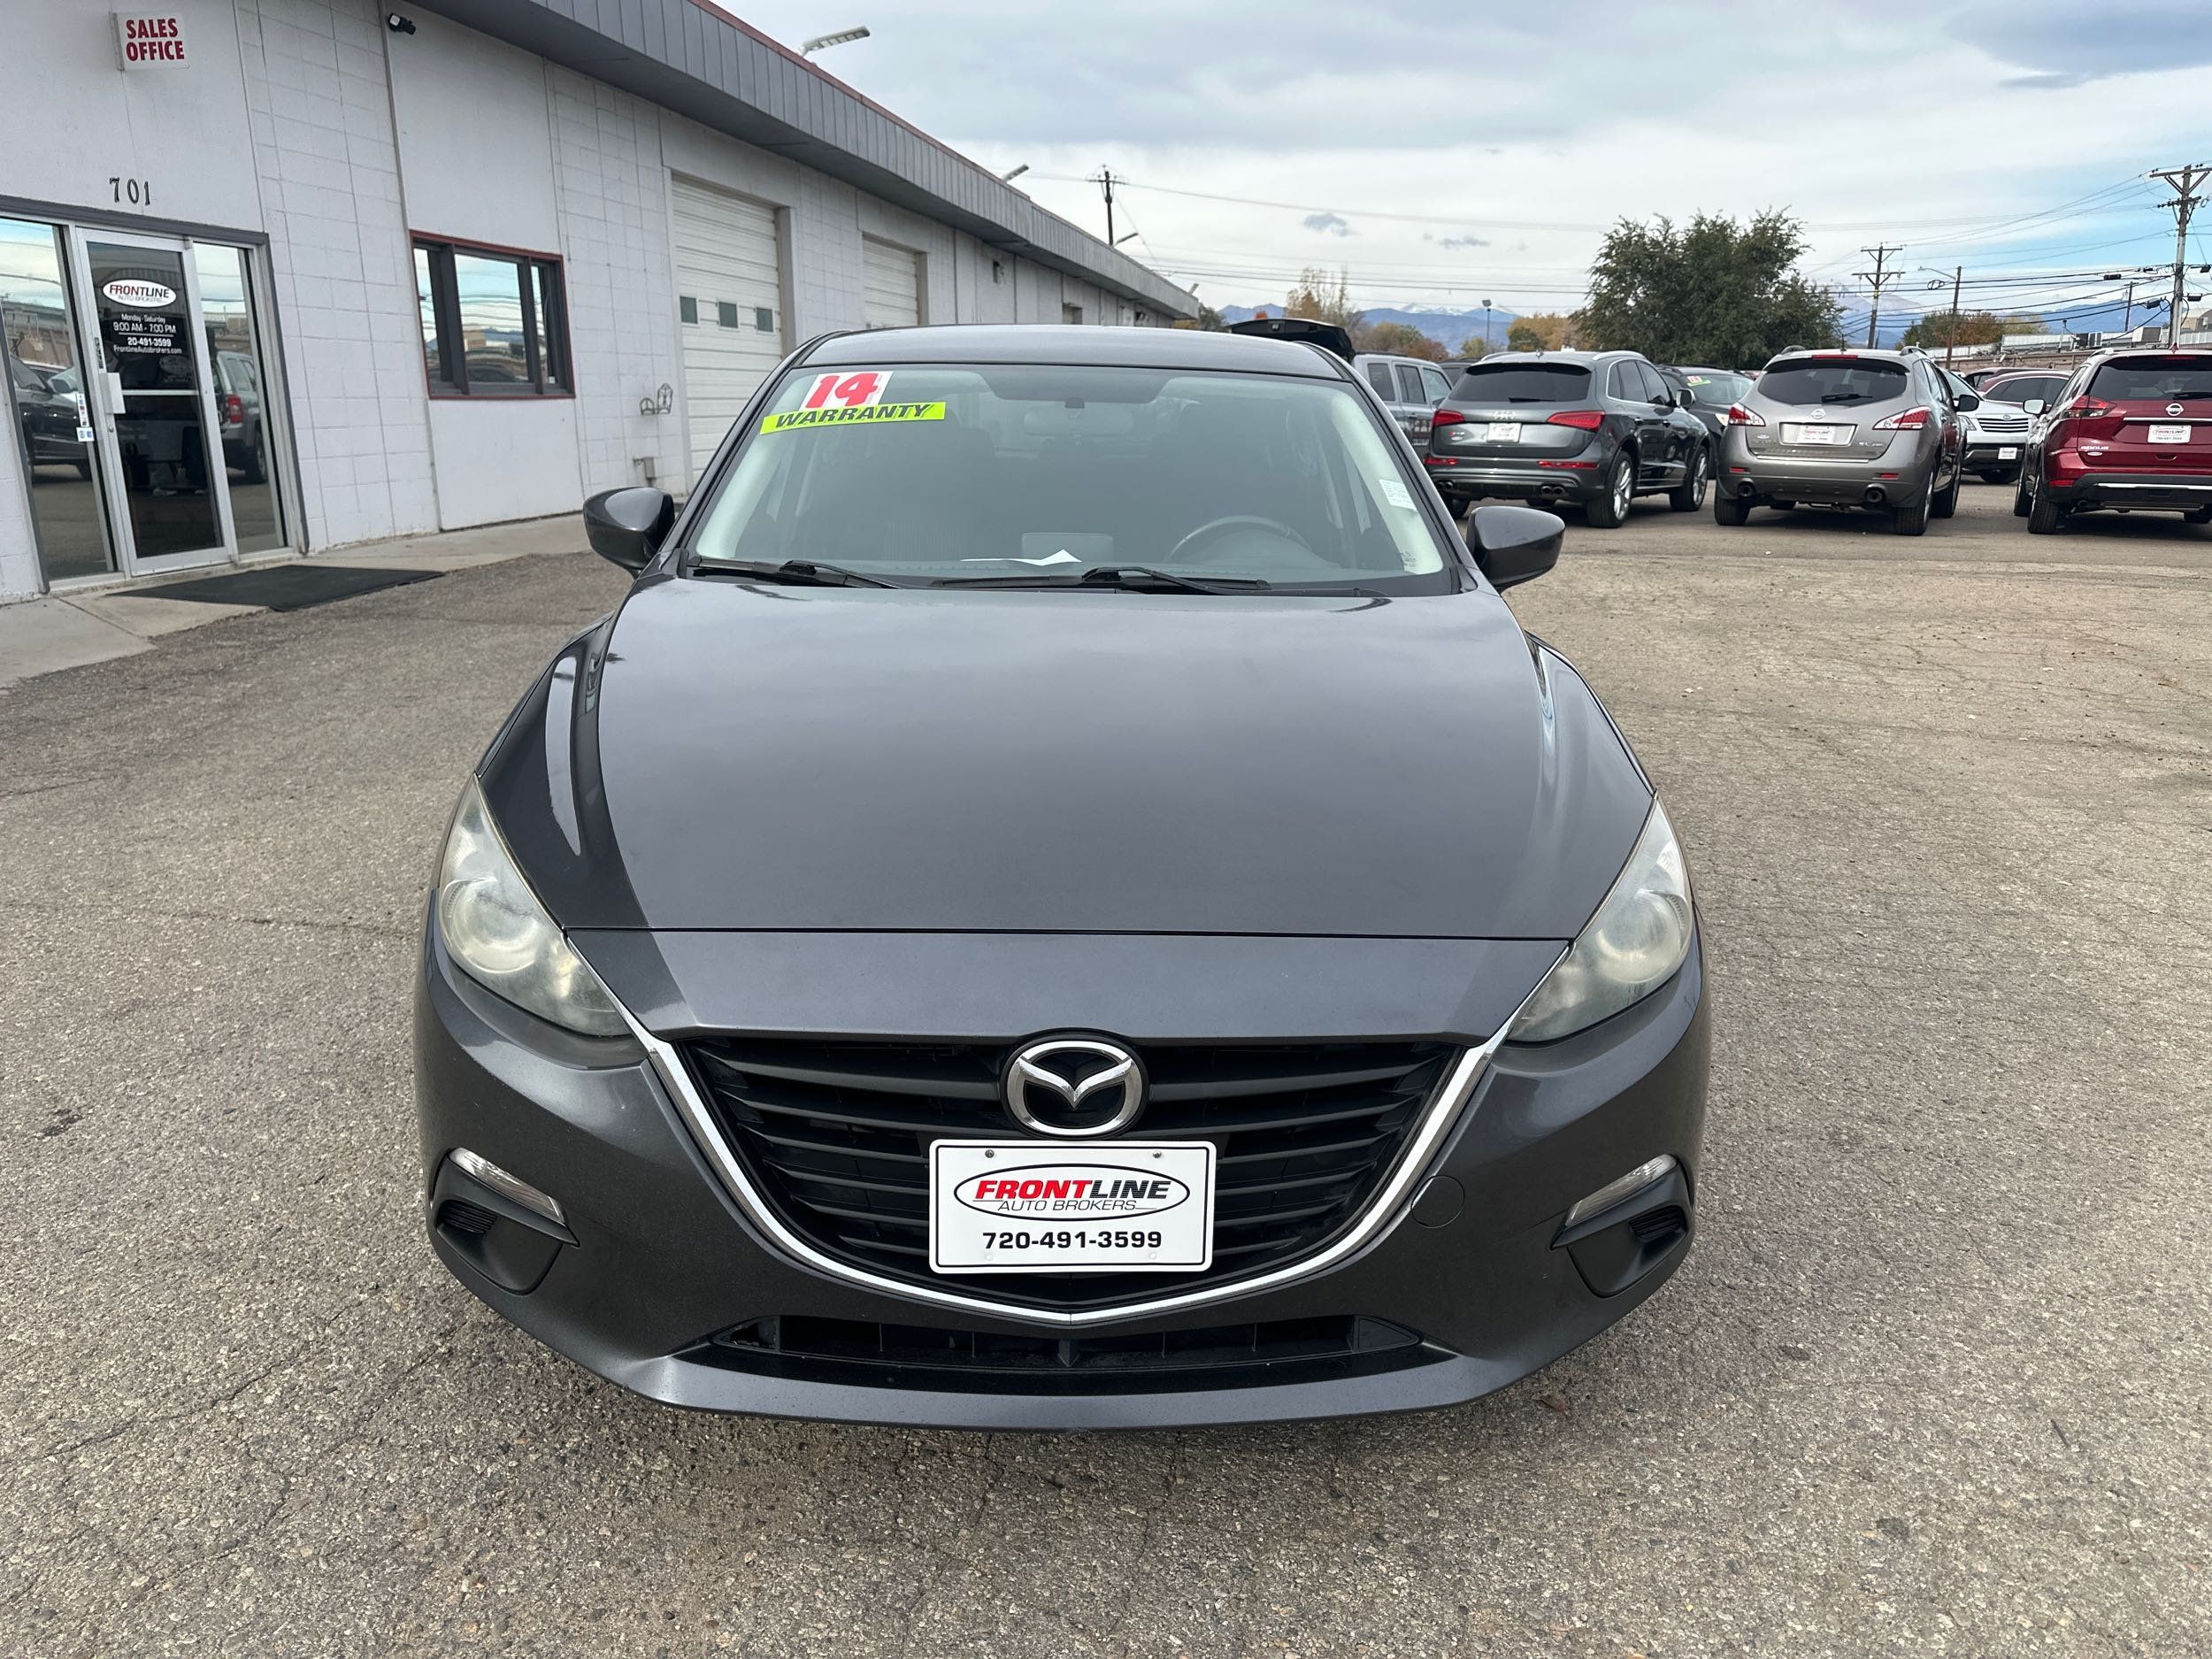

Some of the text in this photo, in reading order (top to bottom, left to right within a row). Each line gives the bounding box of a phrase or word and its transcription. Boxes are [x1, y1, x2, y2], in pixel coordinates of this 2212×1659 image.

[126, 18, 179, 39] SALES
[126, 41, 185, 61] OFFICE
[109, 177, 150, 206] 701
[109, 284, 170, 298] FRONTLINE
[113, 321, 130, 332] 9:00
[131, 322, 143, 332] AM
[149, 323, 164, 334] 7:00
[165, 324, 177, 334] PM
[121, 313, 142, 323] Monday
[143, 314, 165, 325] Saturday
[805, 373, 879, 409] 14
[775, 404, 933, 428] WARRANTY
[974, 1179, 1171, 1200] FRONTLINE
[997, 1200, 1136, 1211] AUTO BROKERS
[982, 1231, 1163, 1249] 720-491-3599
